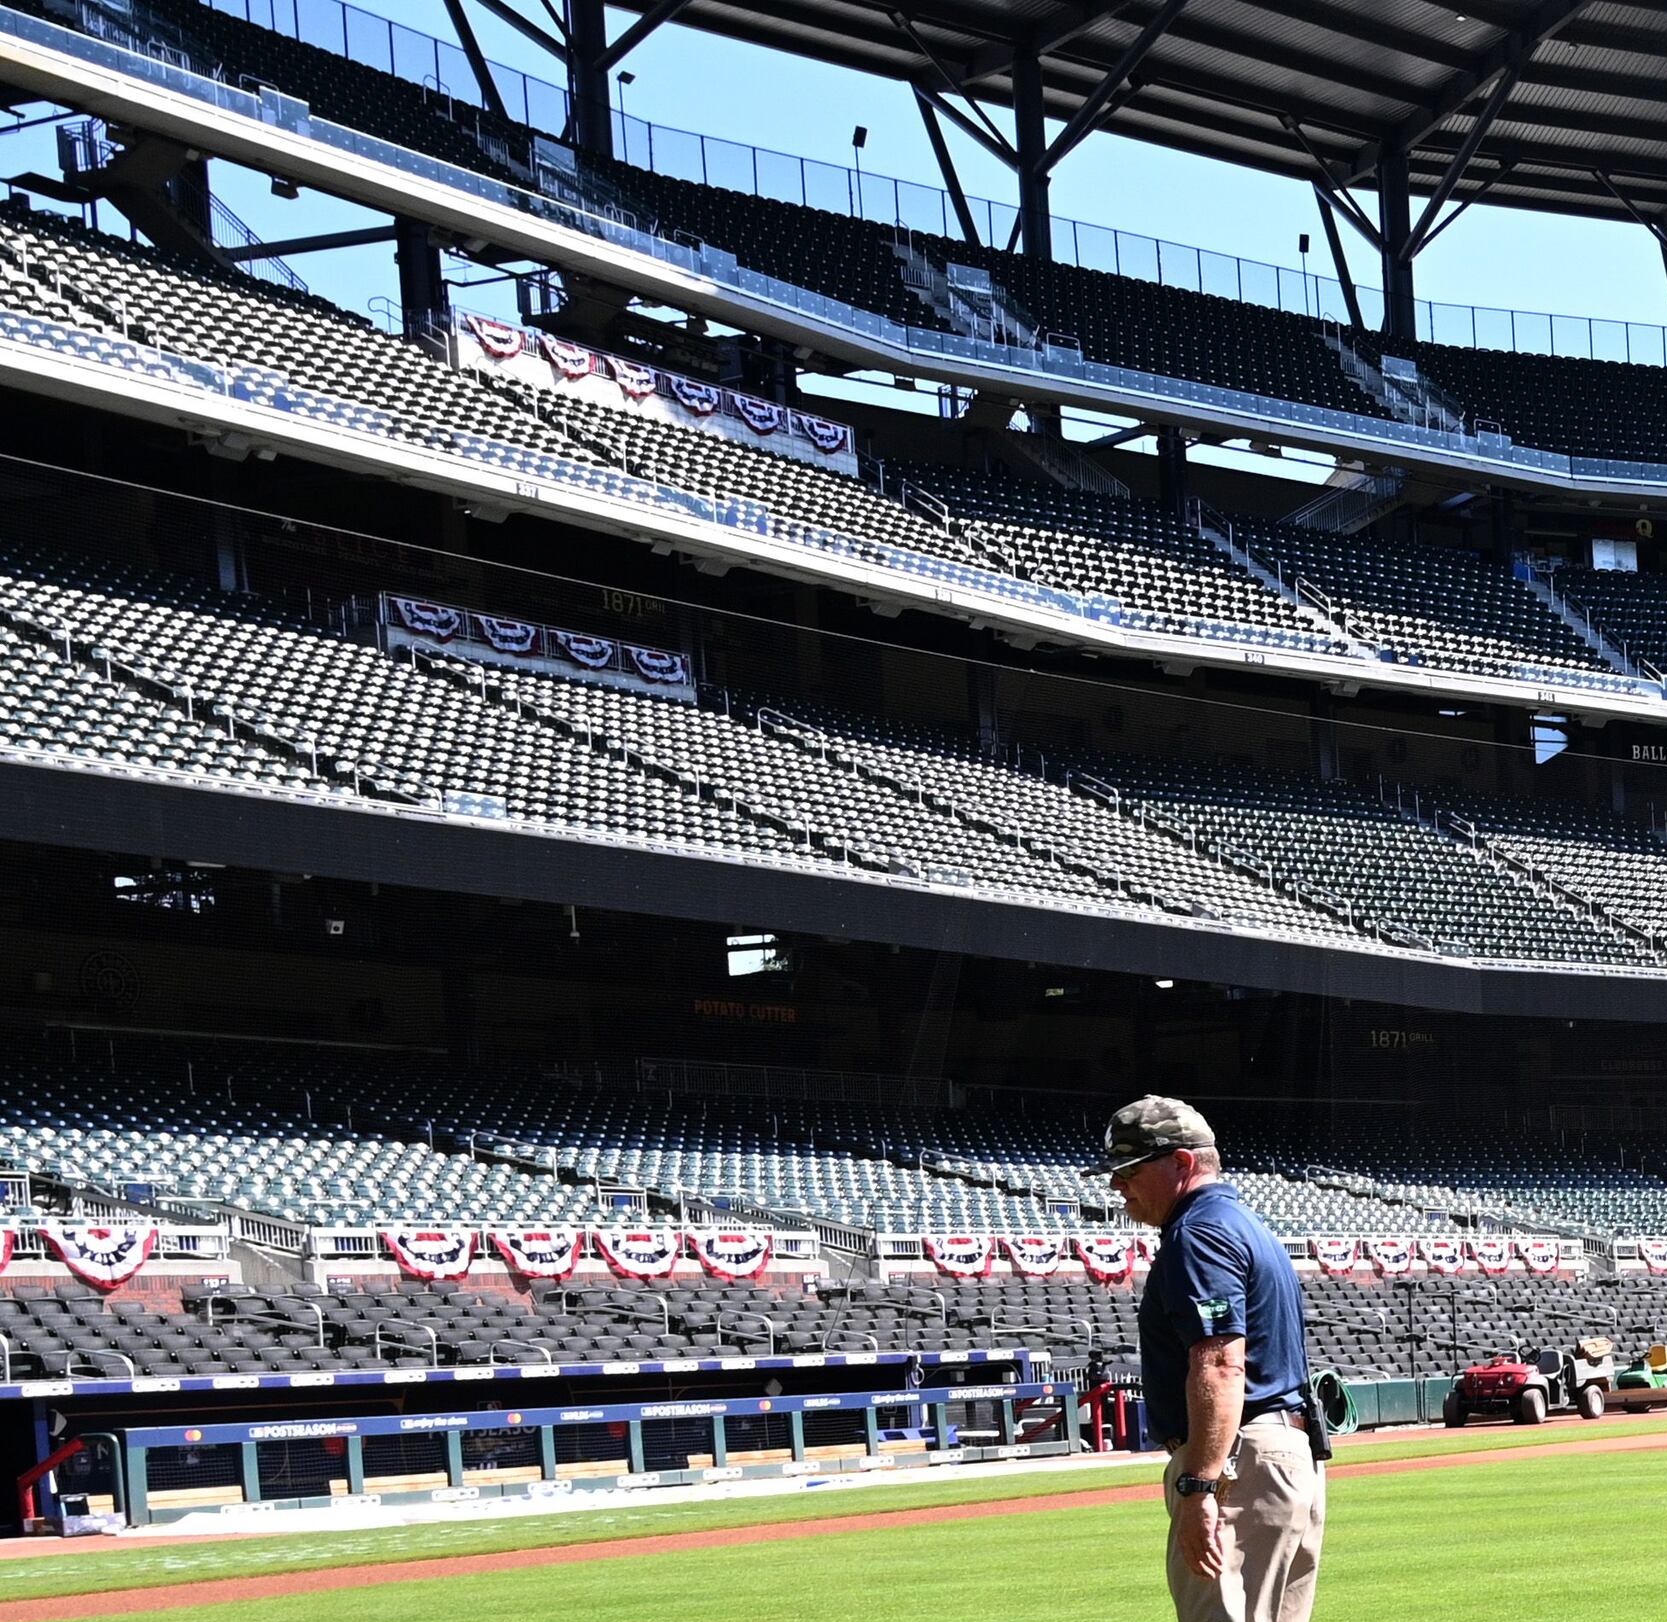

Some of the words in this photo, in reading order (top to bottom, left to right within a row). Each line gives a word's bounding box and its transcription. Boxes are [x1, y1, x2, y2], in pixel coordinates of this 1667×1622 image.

[600, 589, 643, 616] 1871
[694, 999, 746, 1019] POTATO
[750, 1004, 797, 1023] CUTTER
[1370, 1029, 1408, 1048] 1871
[1409, 1032, 1435, 1042] GRILL
[653, 1404, 711, 1416] POSTSEASON
[264, 1423, 337, 1438] POSTSEASON
